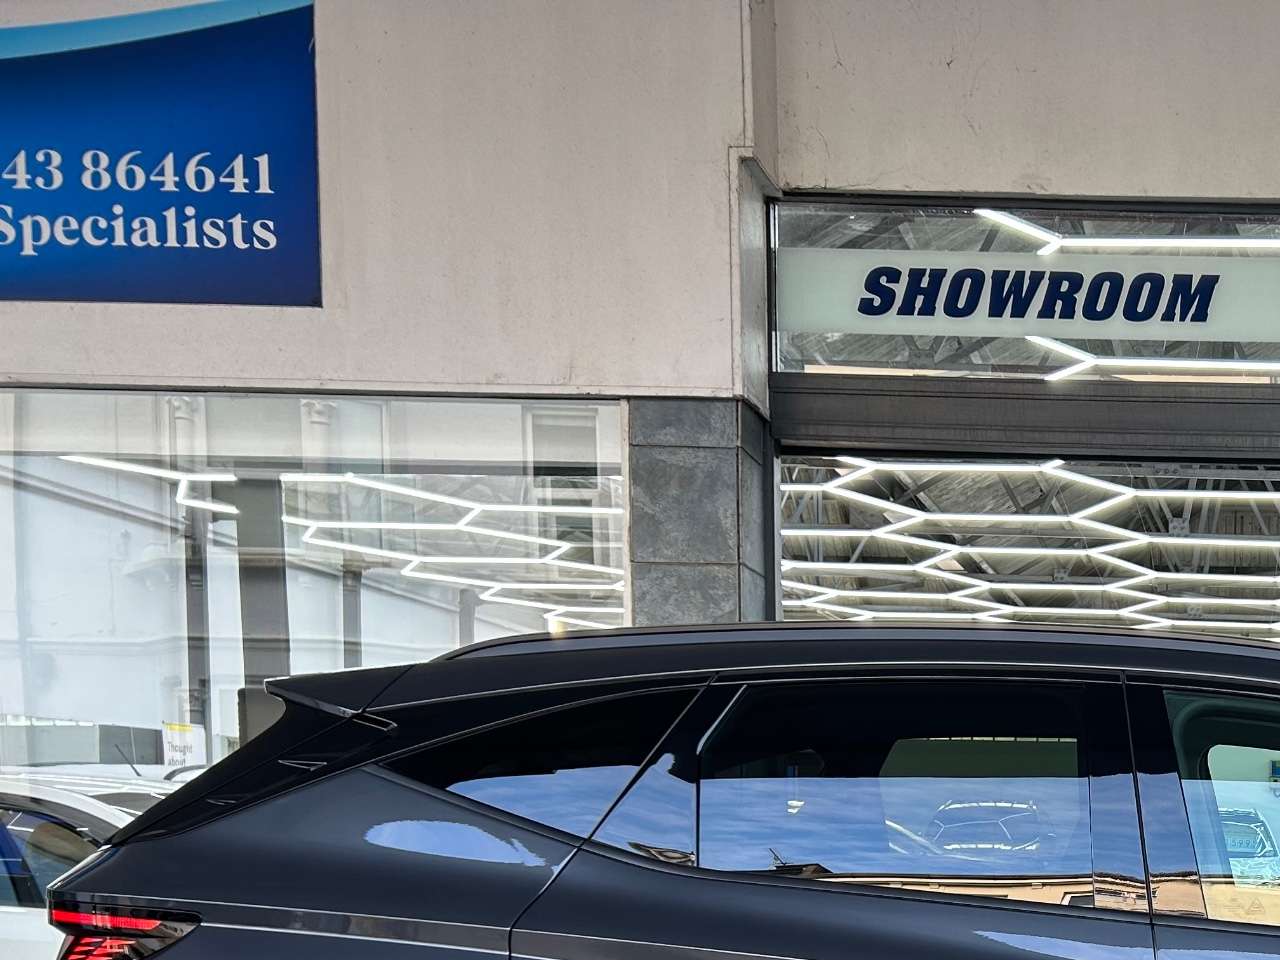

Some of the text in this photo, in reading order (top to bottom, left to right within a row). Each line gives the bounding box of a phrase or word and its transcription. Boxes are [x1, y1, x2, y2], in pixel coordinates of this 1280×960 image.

[1, 149, 275, 194] 43 864641
[0, 203, 278, 256] Specialists
[857, 265, 1220, 323] SHOWROOM
